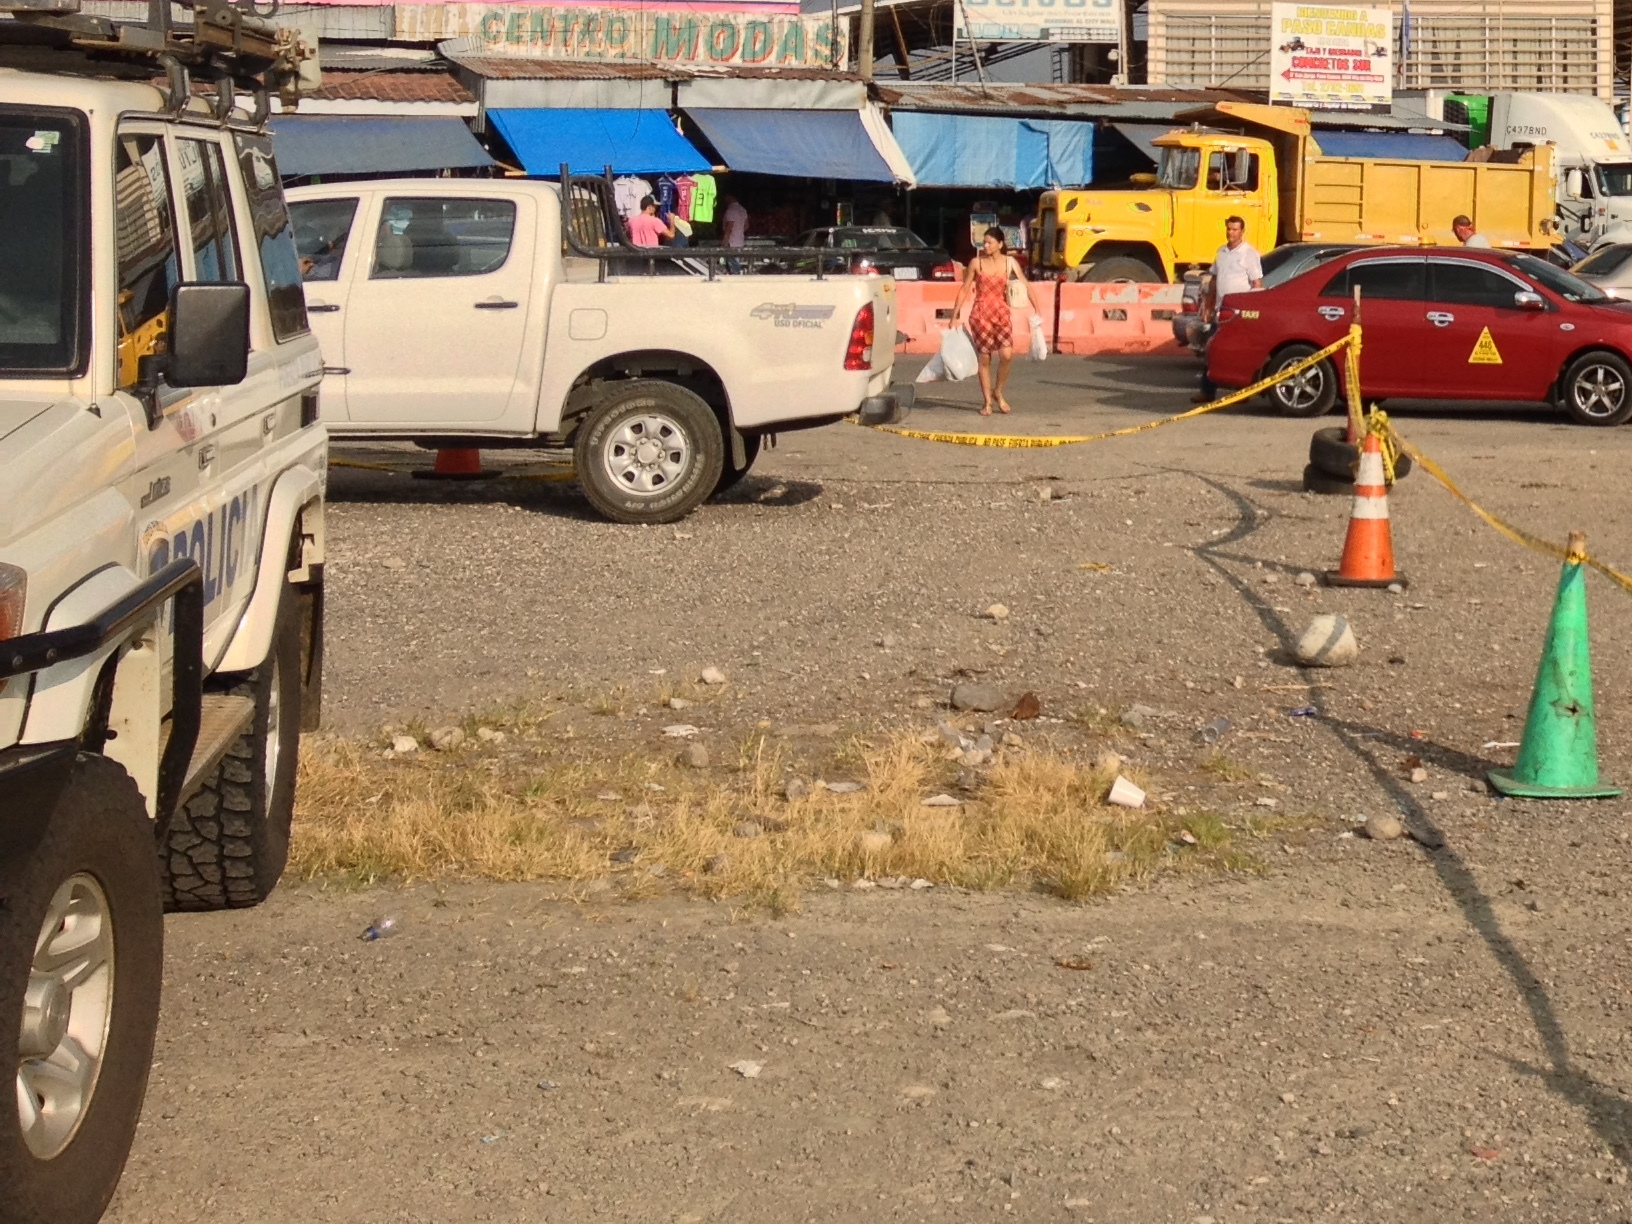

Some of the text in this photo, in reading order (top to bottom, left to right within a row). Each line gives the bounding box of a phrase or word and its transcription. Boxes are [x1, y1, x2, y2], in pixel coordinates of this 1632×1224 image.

[1296, 6, 1369, 22] BIENVENIDO A
[1281, 18, 1386, 38] PASO CANOAS
[481, 11, 846, 65] CENTRO MODAS
[1241, 309, 1260, 320] TAXI
[774, 319, 823, 329] USO OFICIAL
